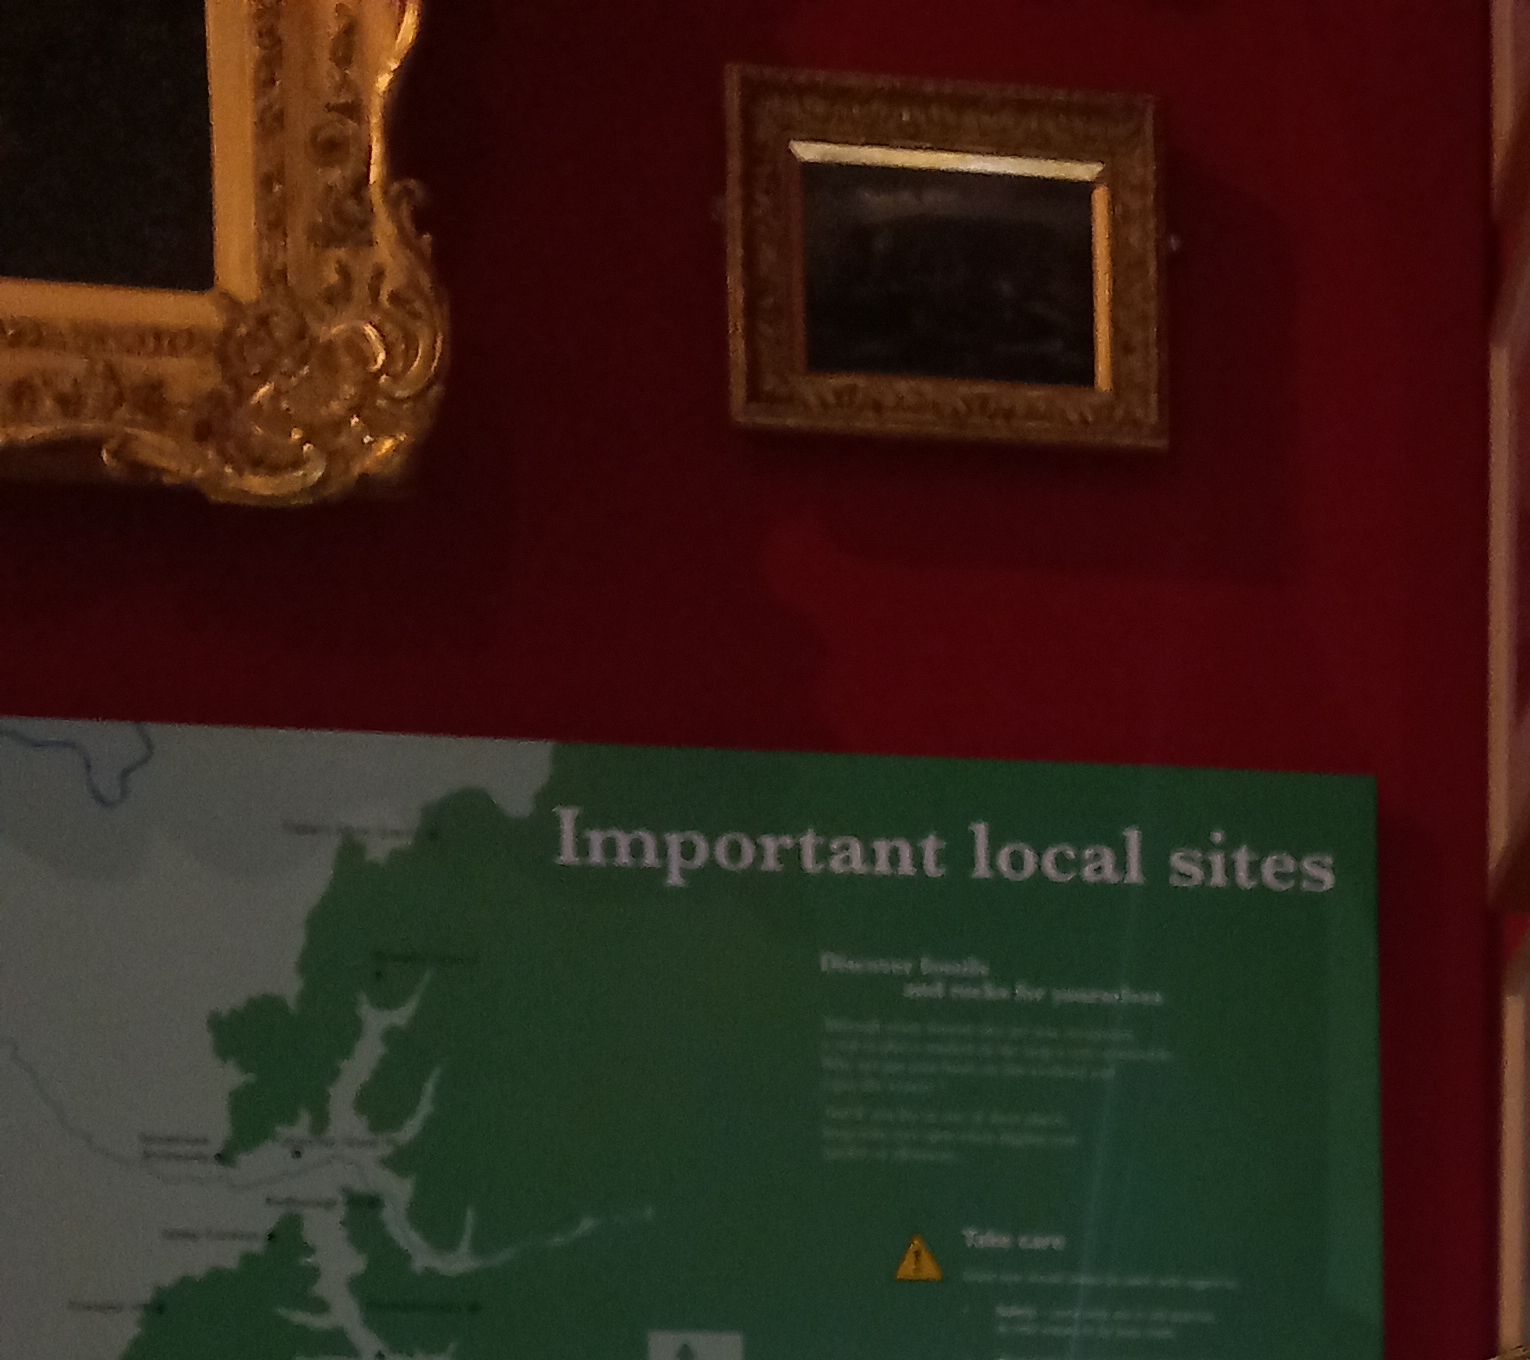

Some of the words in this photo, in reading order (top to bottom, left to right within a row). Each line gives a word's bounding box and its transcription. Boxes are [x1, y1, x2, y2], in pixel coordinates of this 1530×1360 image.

[553, 806, 946, 887] Important
[969, 821, 1145, 887] local
[1167, 830, 1338, 894] sites
[961, 1226, 1013, 1250] Take
